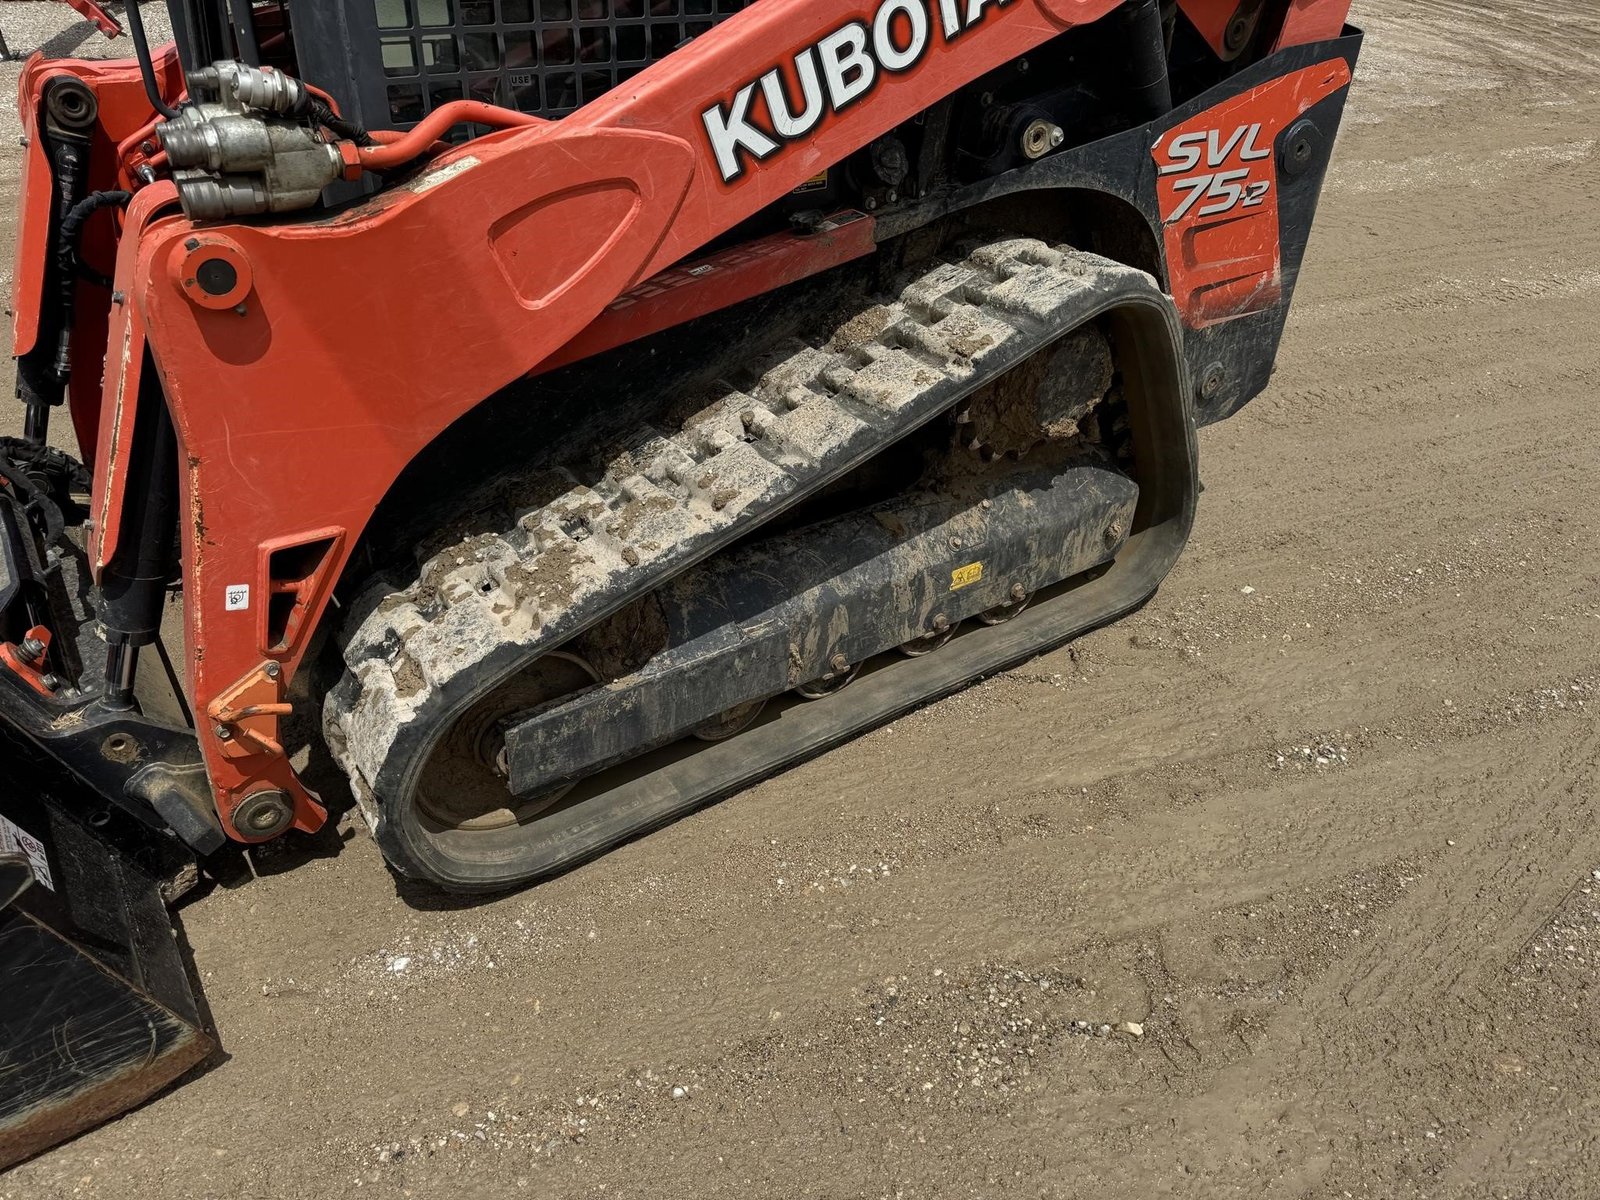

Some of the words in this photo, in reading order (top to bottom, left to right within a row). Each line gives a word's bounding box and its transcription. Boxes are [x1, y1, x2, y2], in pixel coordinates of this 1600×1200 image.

[511, 75, 530, 84] USE
[702, 0, 1005, 181] KUBO
[1158, 123, 1271, 175] SVL
